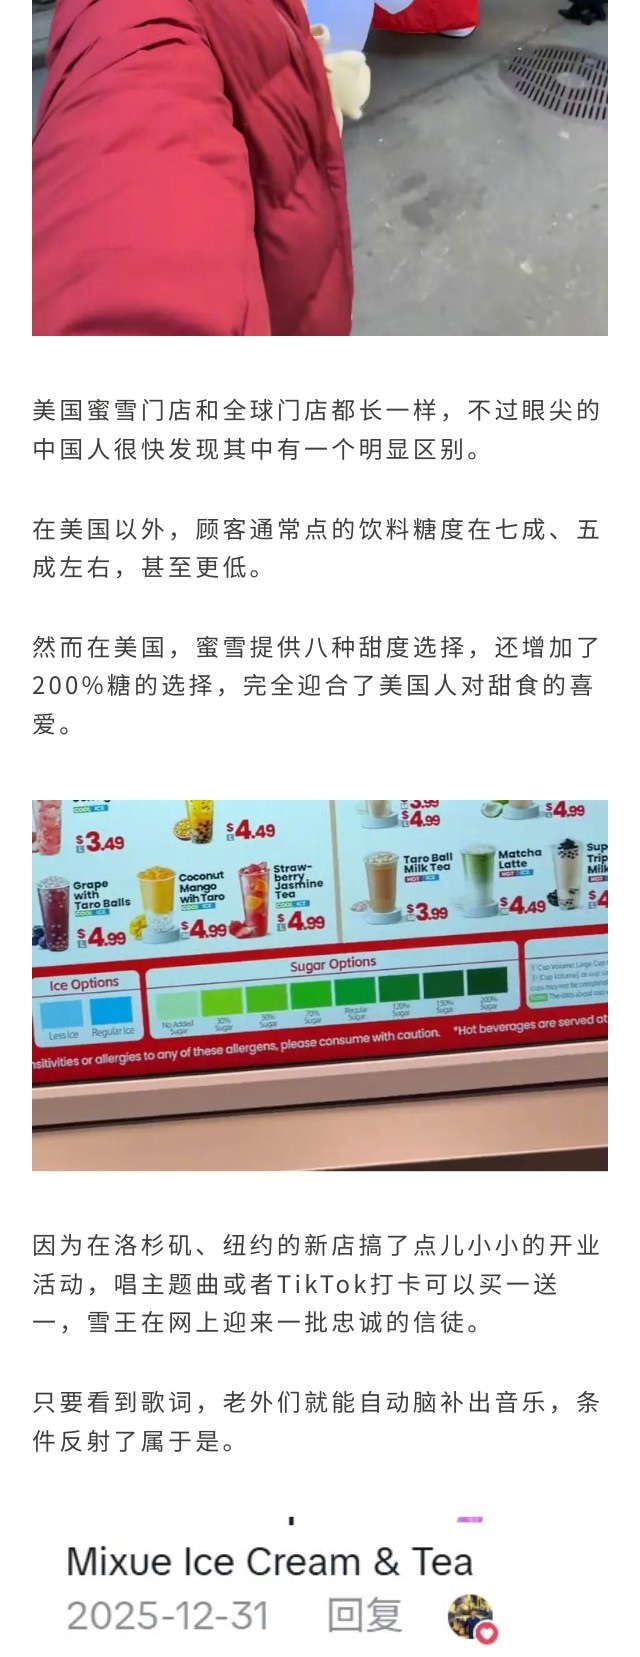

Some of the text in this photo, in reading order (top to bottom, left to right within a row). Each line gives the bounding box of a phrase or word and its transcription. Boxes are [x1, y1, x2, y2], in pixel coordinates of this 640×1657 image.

[33, 399, 598, 421] 美国蜜雪门店和全球门店都长一样，不过眼尖的
[34, 438, 476, 460] 中国人很快发现其中有一个明显区别。
[33, 518, 599, 540] 在美国以外，顾客通常点的饮料糖度在七成、五
[33, 556, 258, 578] 成左右，甚至更低。
[33, 636, 597, 658] 然而在美国，蜜雪提供八种甜度选择，还增加了
[33, 674, 592, 696] 200%糖的选择，完全迎合了美国人对甜食的喜
[33, 713, 68, 735] 爱。
[404, 852, 453, 864] Taro Ball
[499, 849, 542, 859] Matcha
[499, 860, 527, 869] Latte
[179, 871, 224, 882] Coconut
[404, 863, 451, 873] Milk Tea
[73, 880, 108, 891] Grape
[74, 891, 99, 900] with
[180, 883, 217, 893] Mango
[75, 898, 131, 910] Taro Balls
[201, 893, 225, 902] Taro
[291, 957, 377, 974] Sugar Options
[50, 977, 119, 992] Ice Options
[81, 1028, 441, 1066] or allergies to any of these allergens, please consume with caution.
[34, 1234, 599, 1256] 因为在洛杉矶、纽约的新店搞了点儿小小的开业
[33, 1273, 556, 1296] 活动，唱主题曲或者TikTok打卡可以买一送
[33, 1311, 476, 1334] 一，雪王在网上迎来一批忠诚的信徒。
[33, 1391, 599, 1413] 只要看到歌词，老外们就能自动脑补出音乐，条
[33, 1430, 231, 1452] 件反射了属于是。
[68, 1546, 473, 1576] Mixue Ice Cream & Tea
[68, 1601, 267, 1629] 2025-12-31
